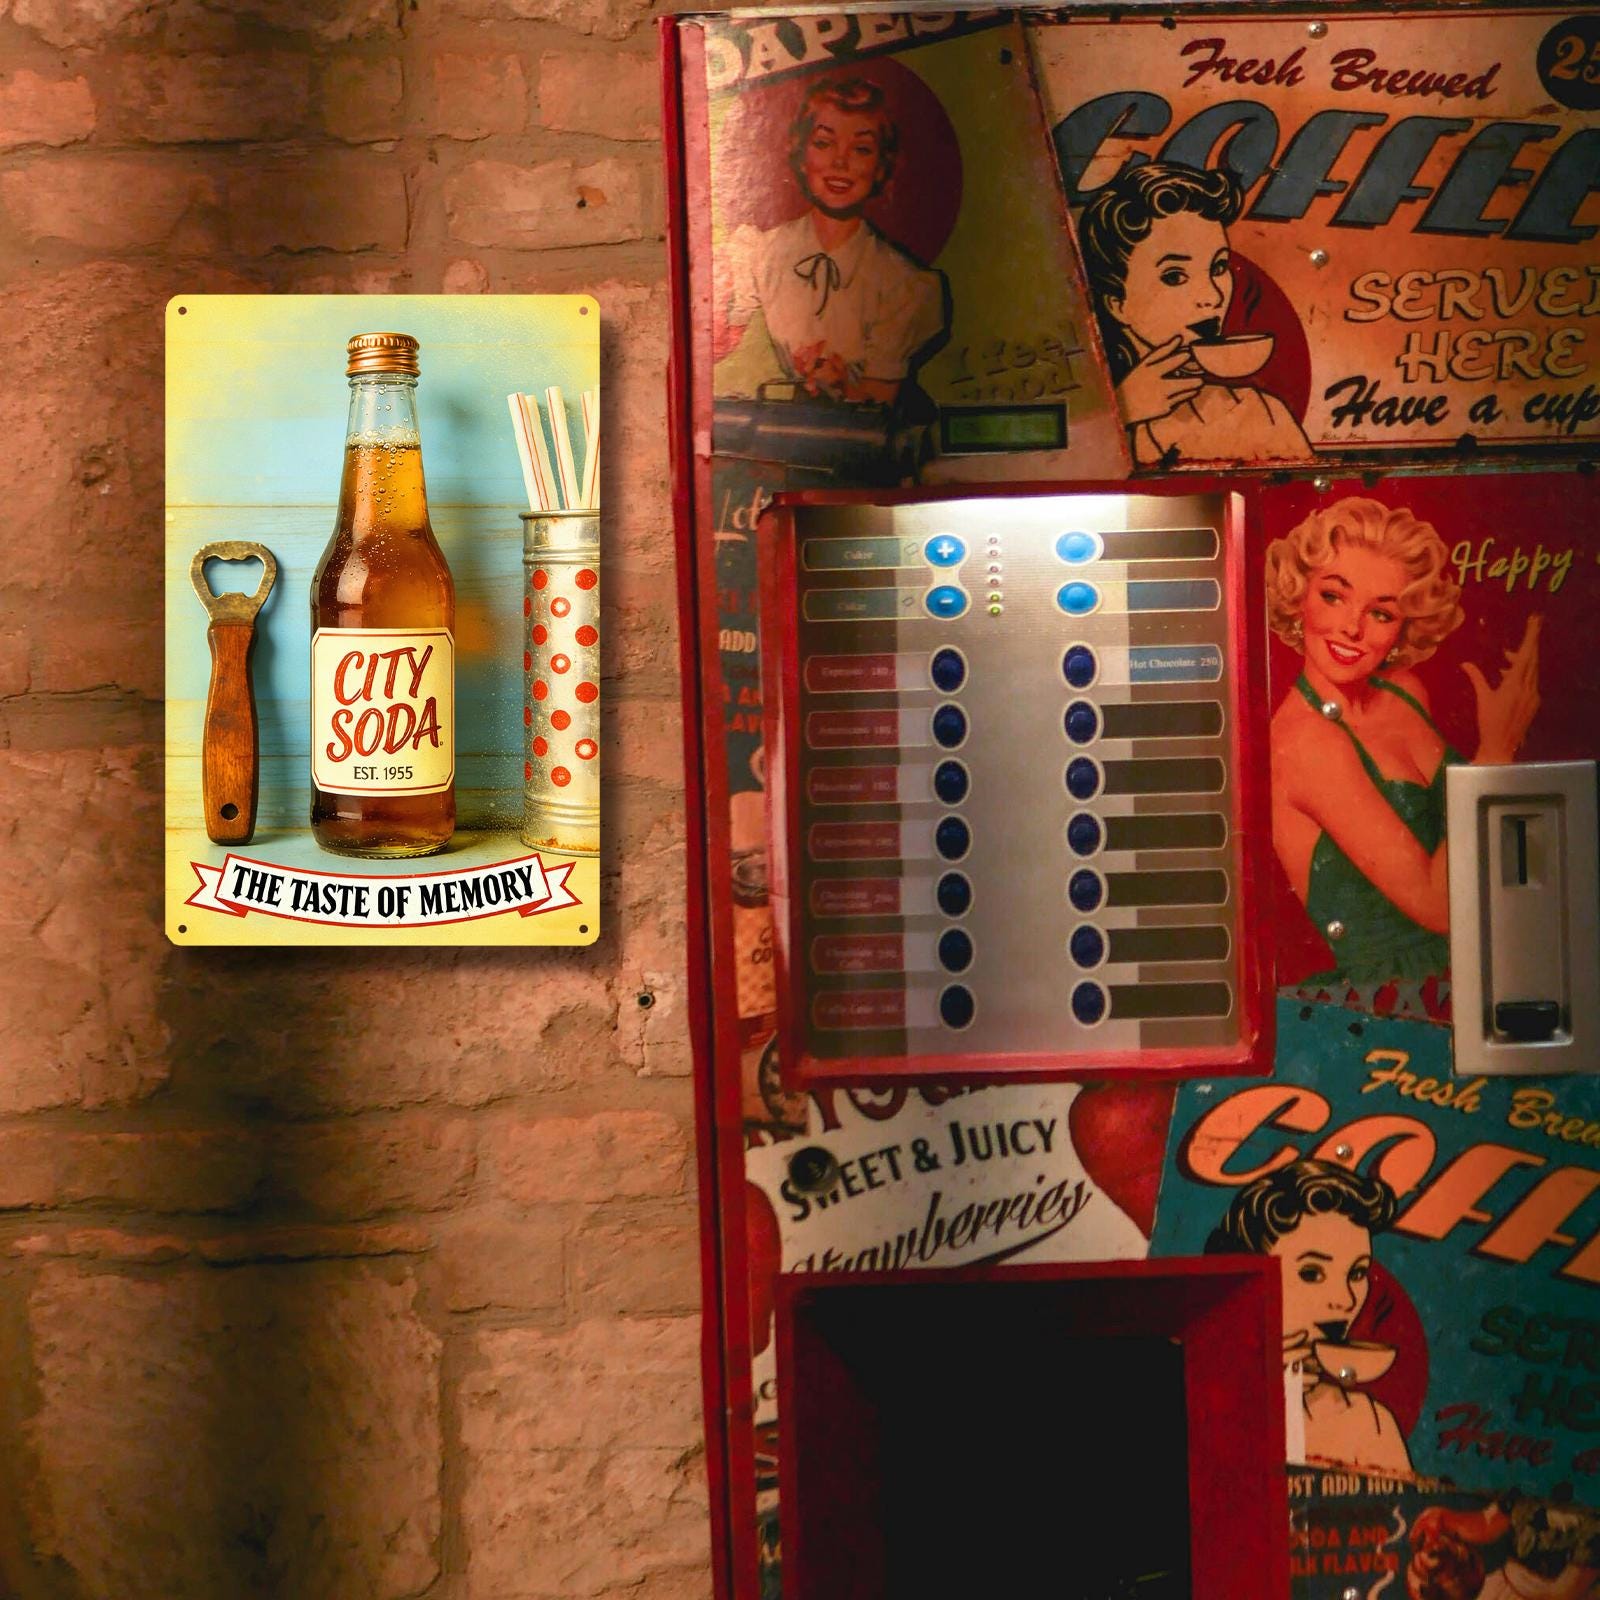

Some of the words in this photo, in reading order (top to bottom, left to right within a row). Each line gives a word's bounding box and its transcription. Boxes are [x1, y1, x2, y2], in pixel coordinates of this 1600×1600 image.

[1181, 38, 1307, 89] Fresh
[1330, 48, 1501, 99] Brewed
[1344, 266, 1600, 324] SERVE
[1400, 328, 1588, 384] HERE
[1325, 375, 1449, 428] Have
[1469, 393, 1501, 423] a
[1451, 539, 1574, 593] Happy
[718, 629, 757, 654] ADD
[334, 645, 434, 706] CITY
[326, 697, 442, 763] SODA
[354, 766, 379, 781] EST.
[384, 765, 414, 780] 1955
[232, 863, 285, 906] THE
[289, 878, 372, 917] TASTE
[377, 884, 412, 919] OF
[419, 864, 534, 917] MEMORY
[1361, 1049, 1488, 1115] Fresh
[911, 1138, 942, 1173] &
[949, 1117, 1058, 1167] JUICY
[1435, 1404, 1554, 1466] Have
[1321, 1474, 1361, 1497] ADD
